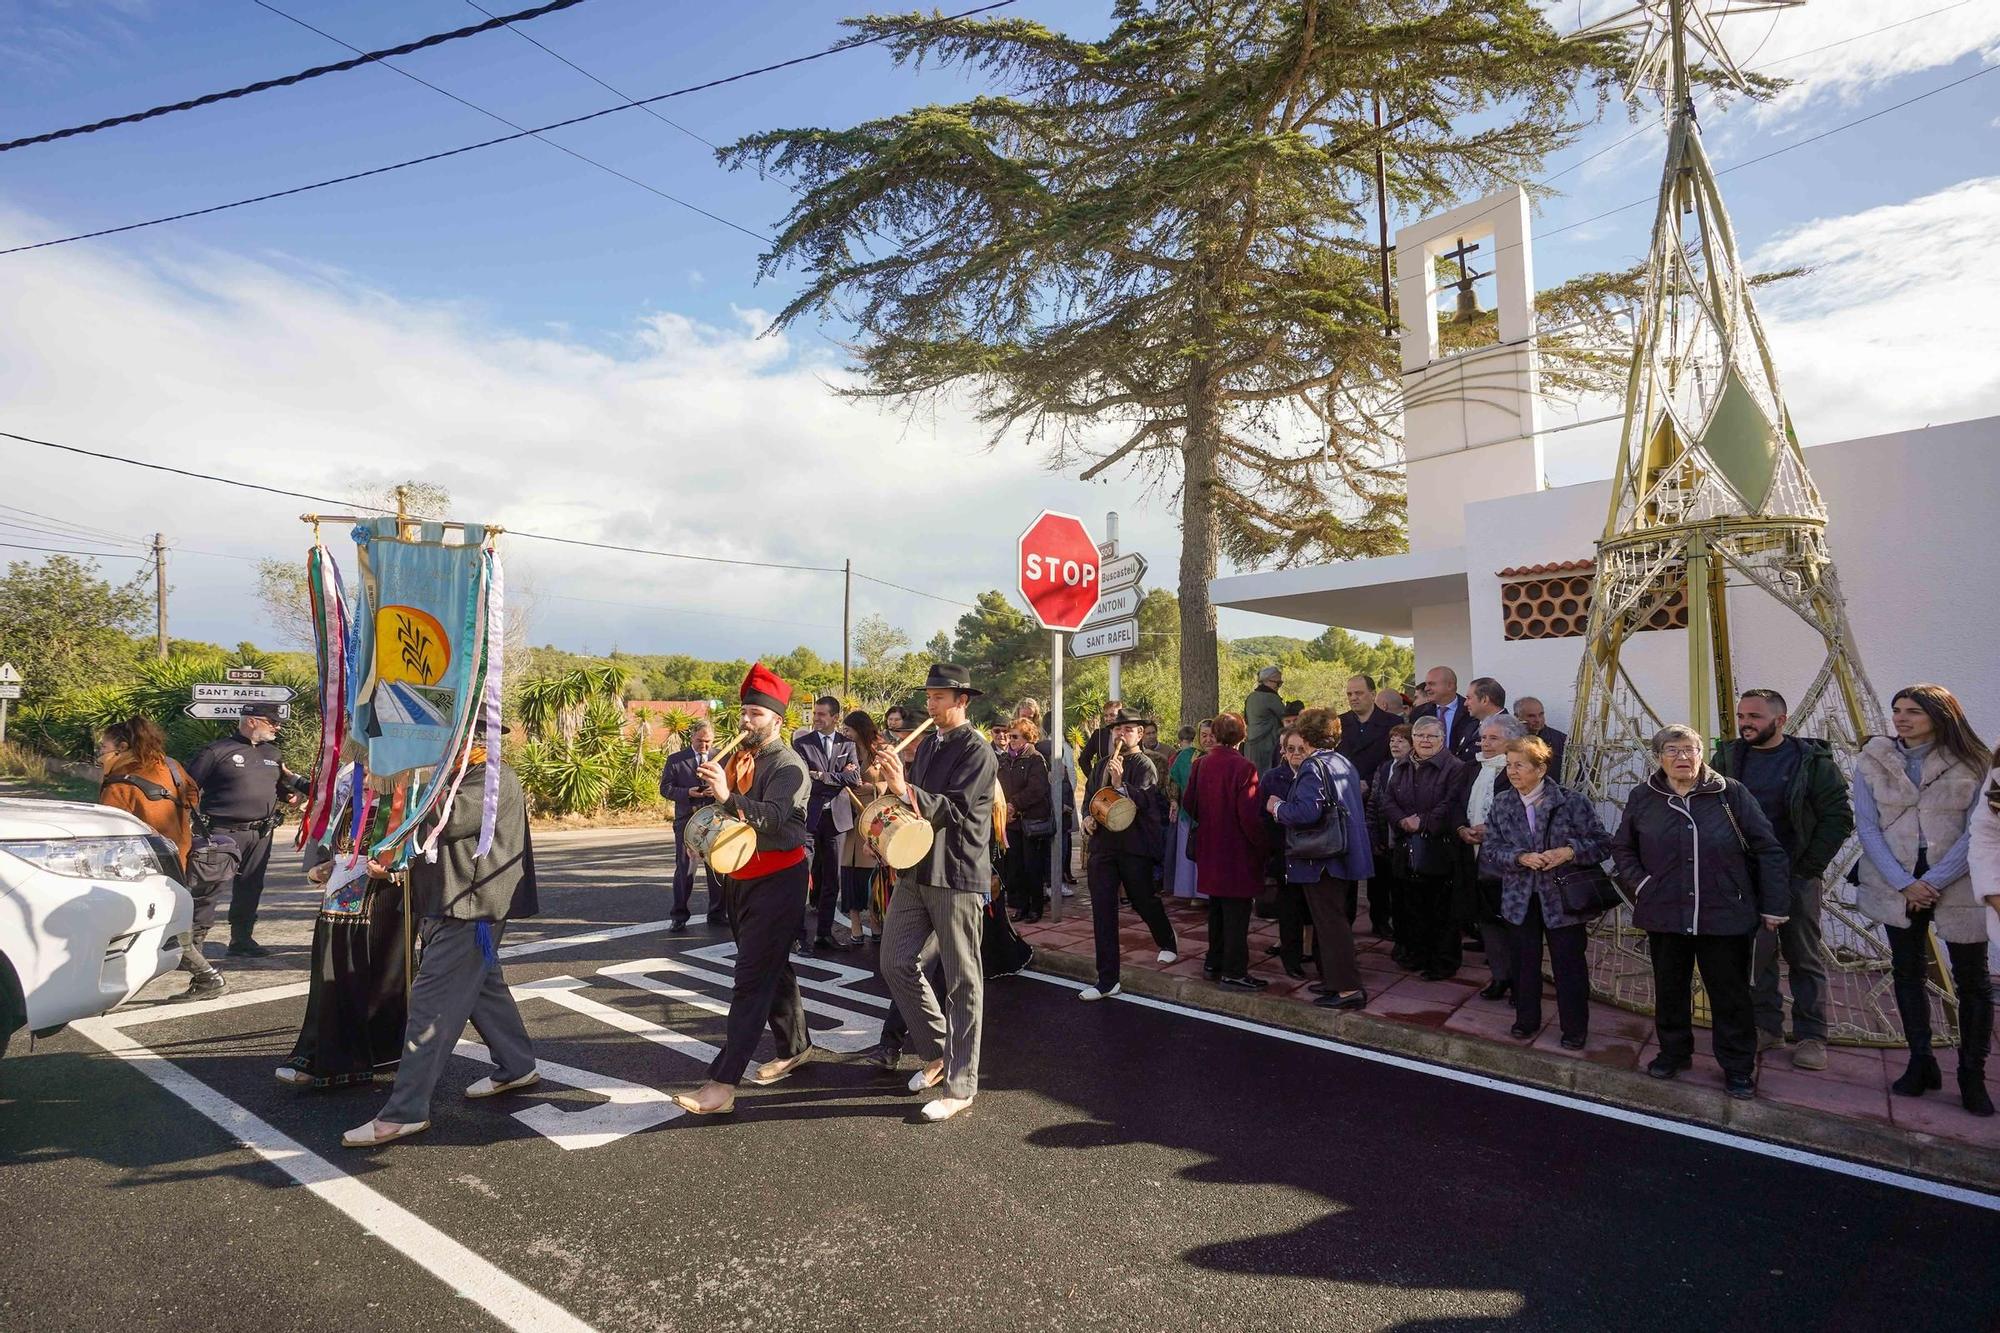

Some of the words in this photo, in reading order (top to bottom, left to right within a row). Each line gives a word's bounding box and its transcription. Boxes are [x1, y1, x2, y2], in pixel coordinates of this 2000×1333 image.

[1025, 552, 1096, 588] STOP
[1101, 562, 1136, 583] Buscastell
[1097, 596, 1126, 614] ANTONI
[1086, 634, 1105, 648] SANT
[1107, 629, 1131, 645] RAFEL
[231, 671, 259, 679] EI-500
[198, 688, 228, 697] SANT
[233, 689, 267, 698] RAFEL
